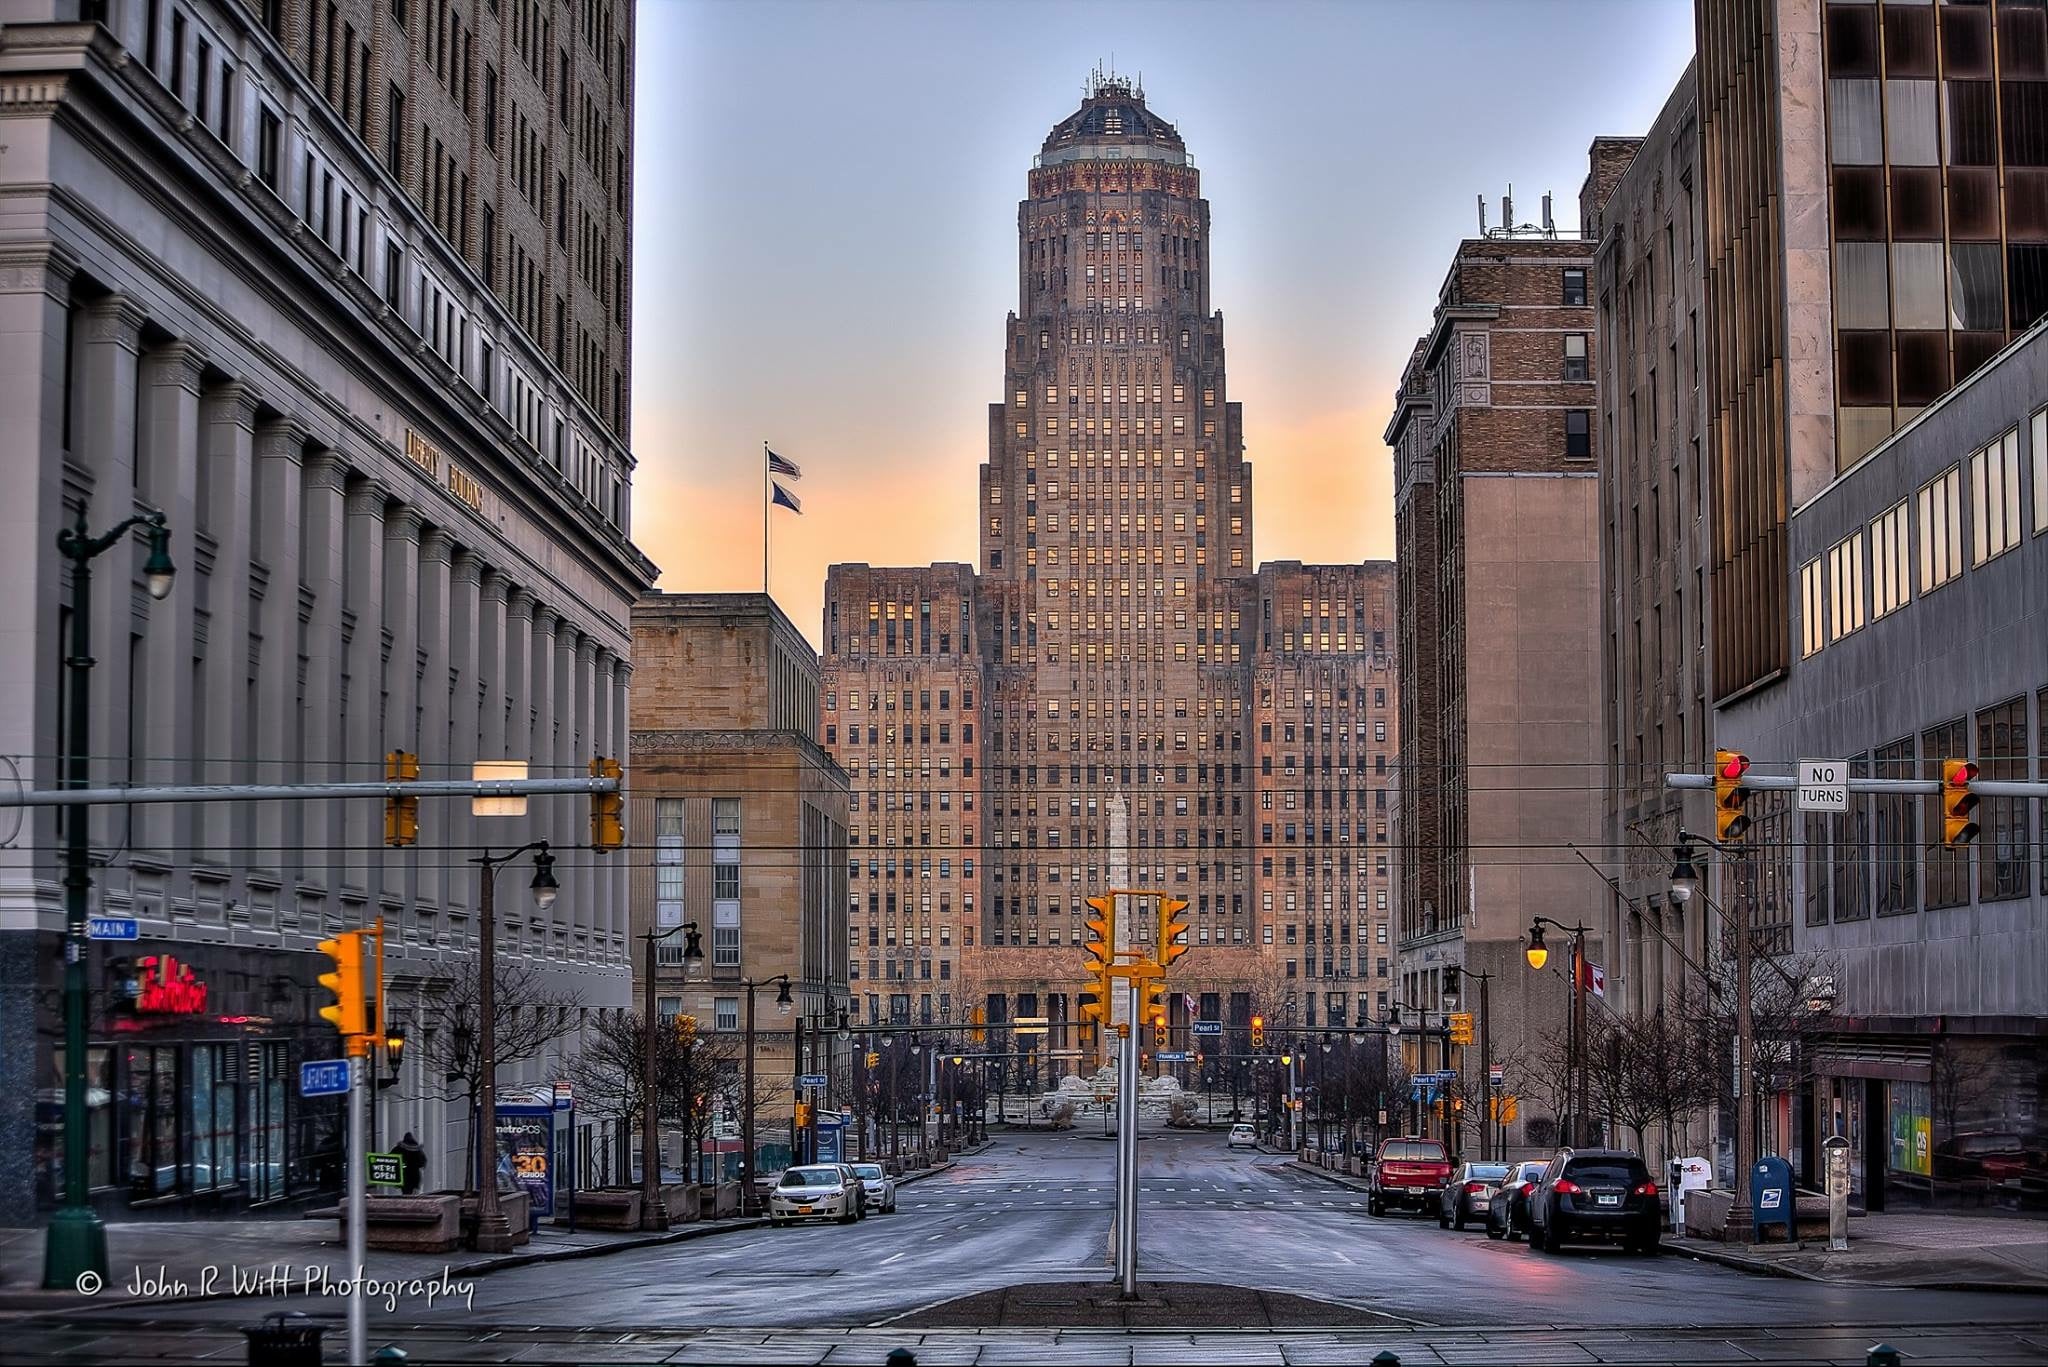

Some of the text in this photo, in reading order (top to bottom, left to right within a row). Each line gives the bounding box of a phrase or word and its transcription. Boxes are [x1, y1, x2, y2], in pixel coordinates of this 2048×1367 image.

[1812, 768, 1835, 783] NO
[1801, 789, 1843, 803] TURNS
[91, 922, 126, 937] MAIN
[1194, 1024, 1212, 1032] Pearl
[1413, 1076, 1429, 1084] Pearl
[373, 1172, 397, 1180] OPEN
